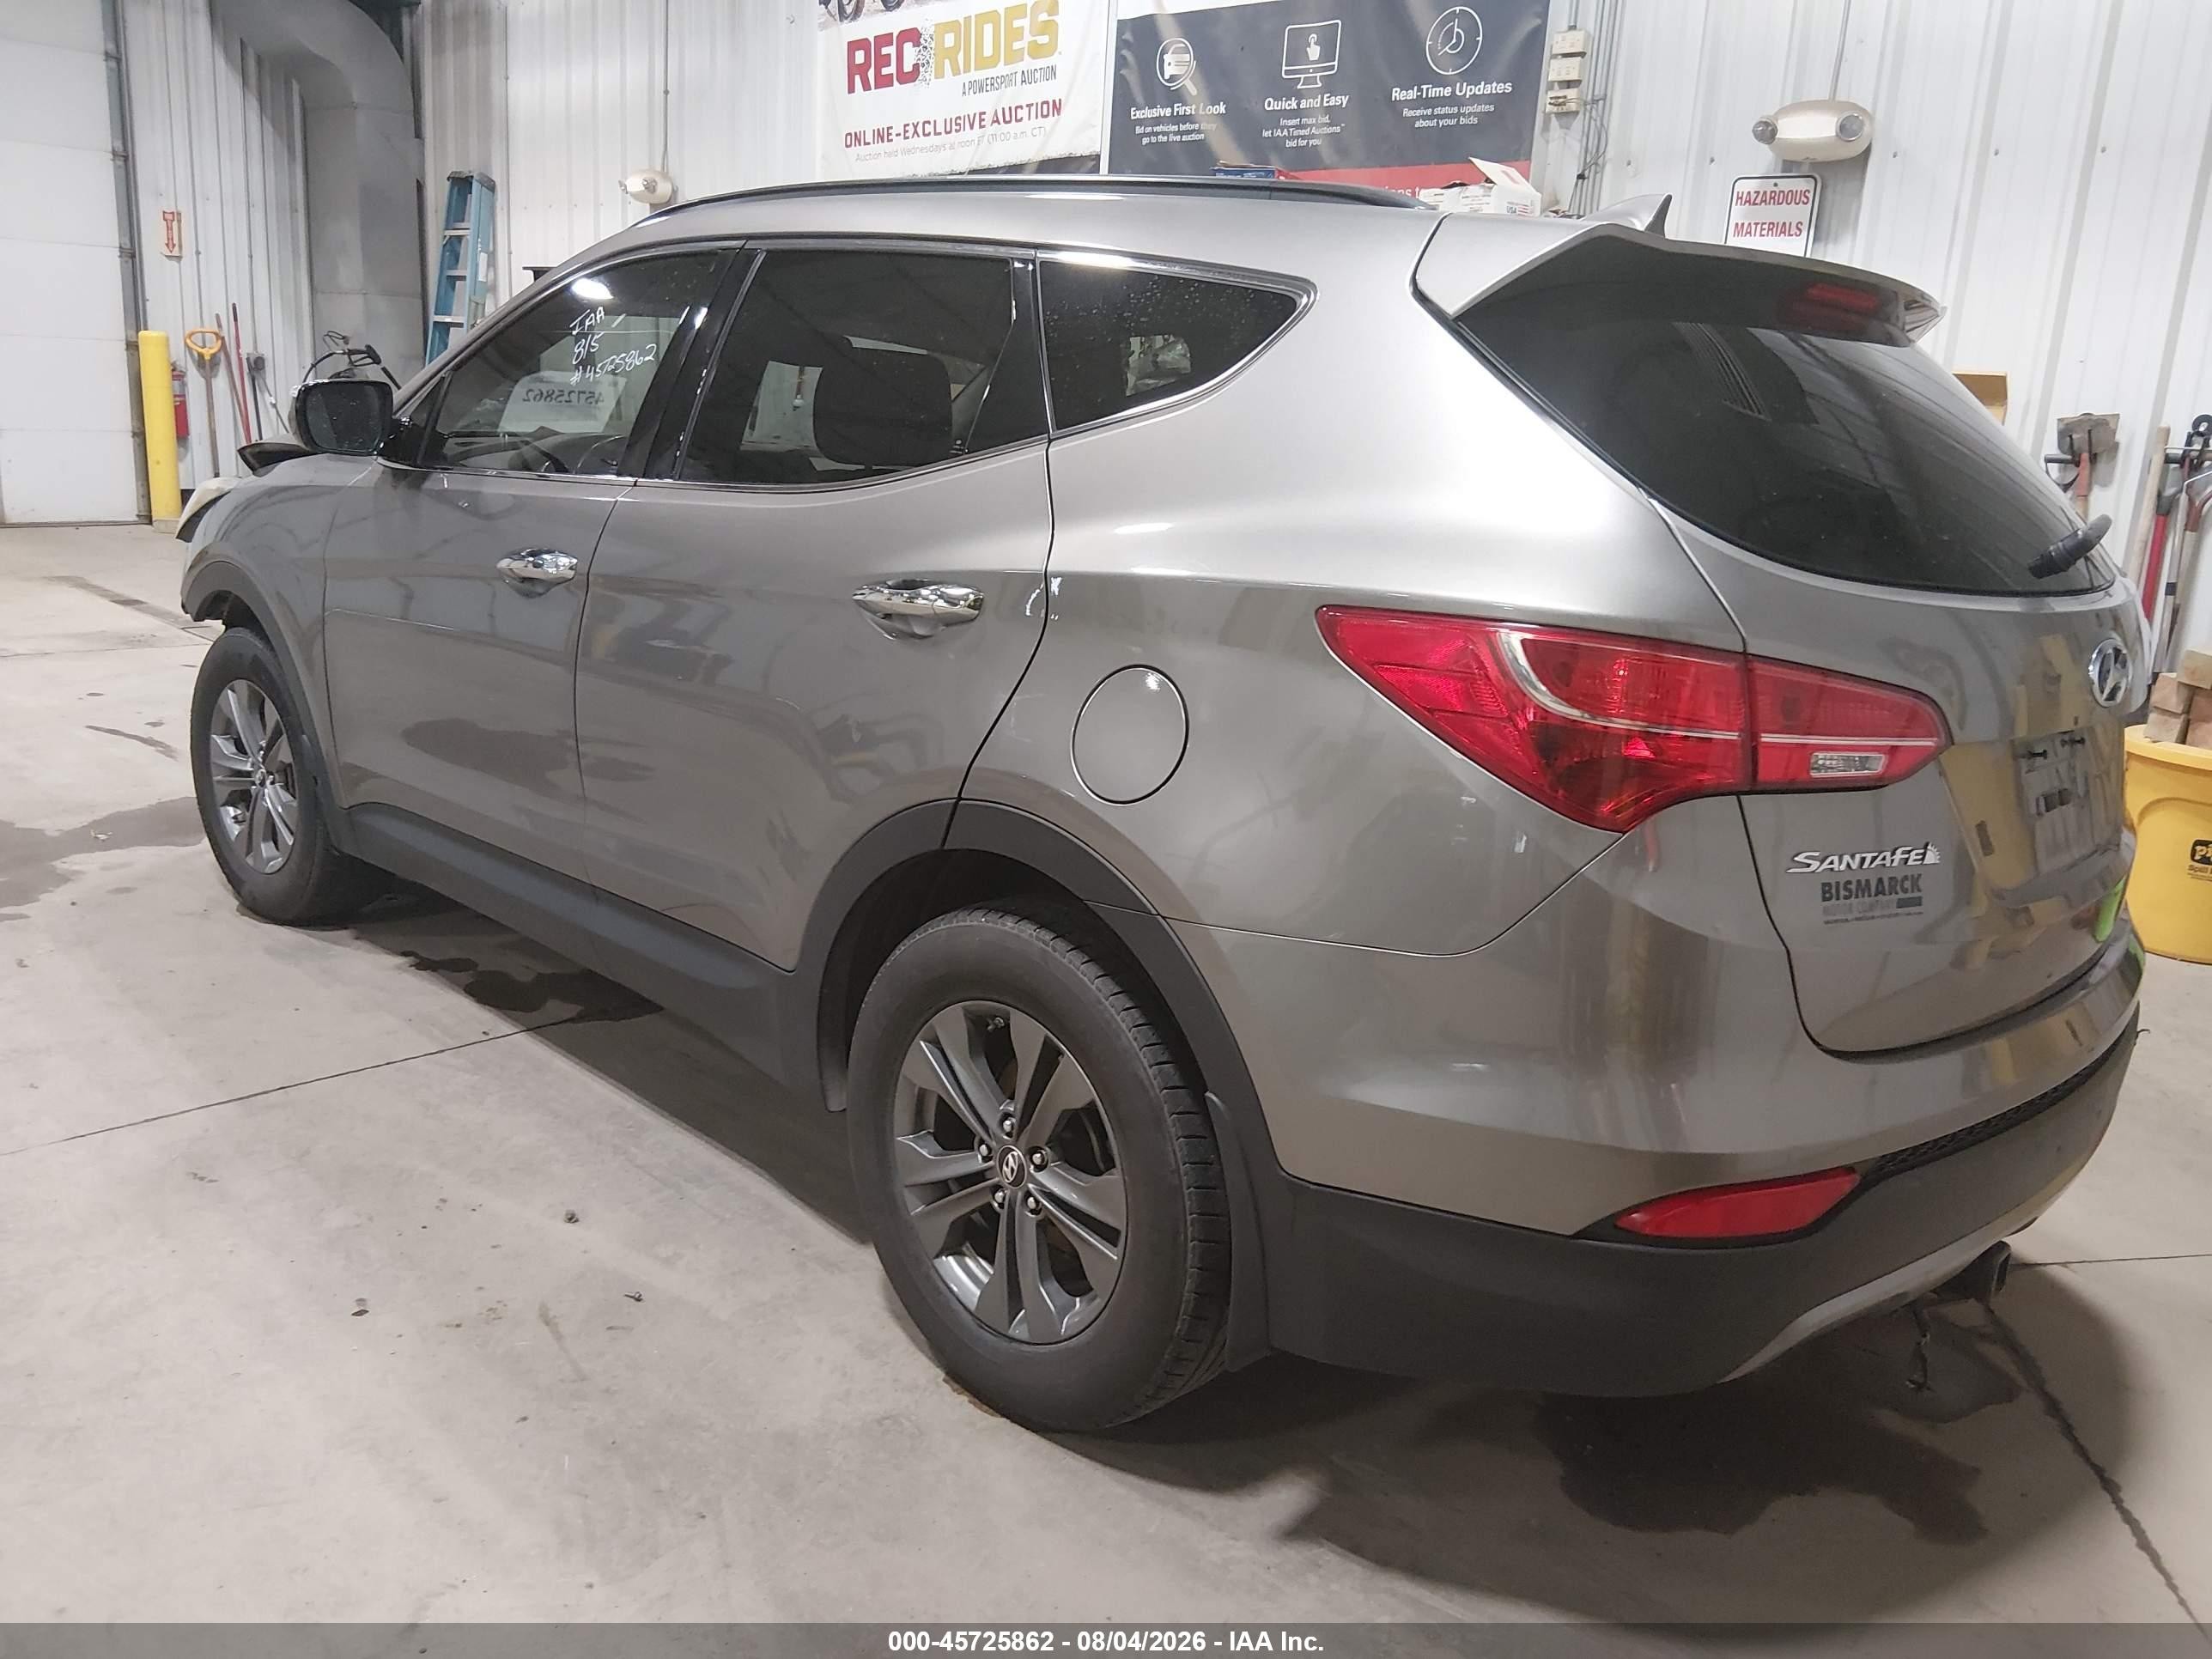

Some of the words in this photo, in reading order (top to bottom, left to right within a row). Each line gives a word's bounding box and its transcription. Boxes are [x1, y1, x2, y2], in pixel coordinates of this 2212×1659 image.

[847, 27, 921, 94] REC
[933, 0, 1060, 80] RIDES
[962, 82, 967, 97] A
[968, 70, 1018, 96] POWERSPORT
[1020, 64, 1057, 86] AUCTION
[1391, 84, 1451, 101] Real-Time
[1455, 81, 1513, 98] Updates
[1130, 105, 1172, 120] Exclusive
[1173, 102, 1196, 116] First
[1199, 101, 1227, 115] Look
[1264, 96, 1298, 111] Quick
[1299, 95, 1322, 109] and
[1322, 93, 1350, 108] Easy
[1402, 107, 1432, 118] Receive
[1433, 106, 1459, 115] status
[1460, 103, 1495, 114] updates
[844, 111, 987, 149] ONLINE-EXCLUSIVE
[990, 98, 1062, 127] AUCTION
[1152, 124, 1178, 133] vehicles
[1179, 121, 1199, 131] before
[1279, 118, 1300, 126] Insert
[1414, 118, 1437, 128] about
[1438, 118, 1458, 128] your
[1459, 115, 1479, 125] bids
[1141, 137, 1150, 146] go
[1158, 134, 1168, 143] the
[1169, 133, 1181, 142] live
[1182, 132, 1205, 142] auction
[1262, 129, 1272, 137] let
[1273, 127, 1288, 137] IAA
[1288, 126, 1310, 137] Timed
[1285, 138, 1297, 148] bid
[1298, 138, 1308, 147] for
[1309, 137, 1322, 148] you
[855, 149, 882, 162] Auction
[899, 143, 947, 156] Wednesdays
[1735, 189, 1811, 207] HAZARDOUS
[1733, 221, 1803, 238] MATERIALS
[569, 306, 605, 336] IAA
[1820, 873, 1923, 902] BISMARCK
